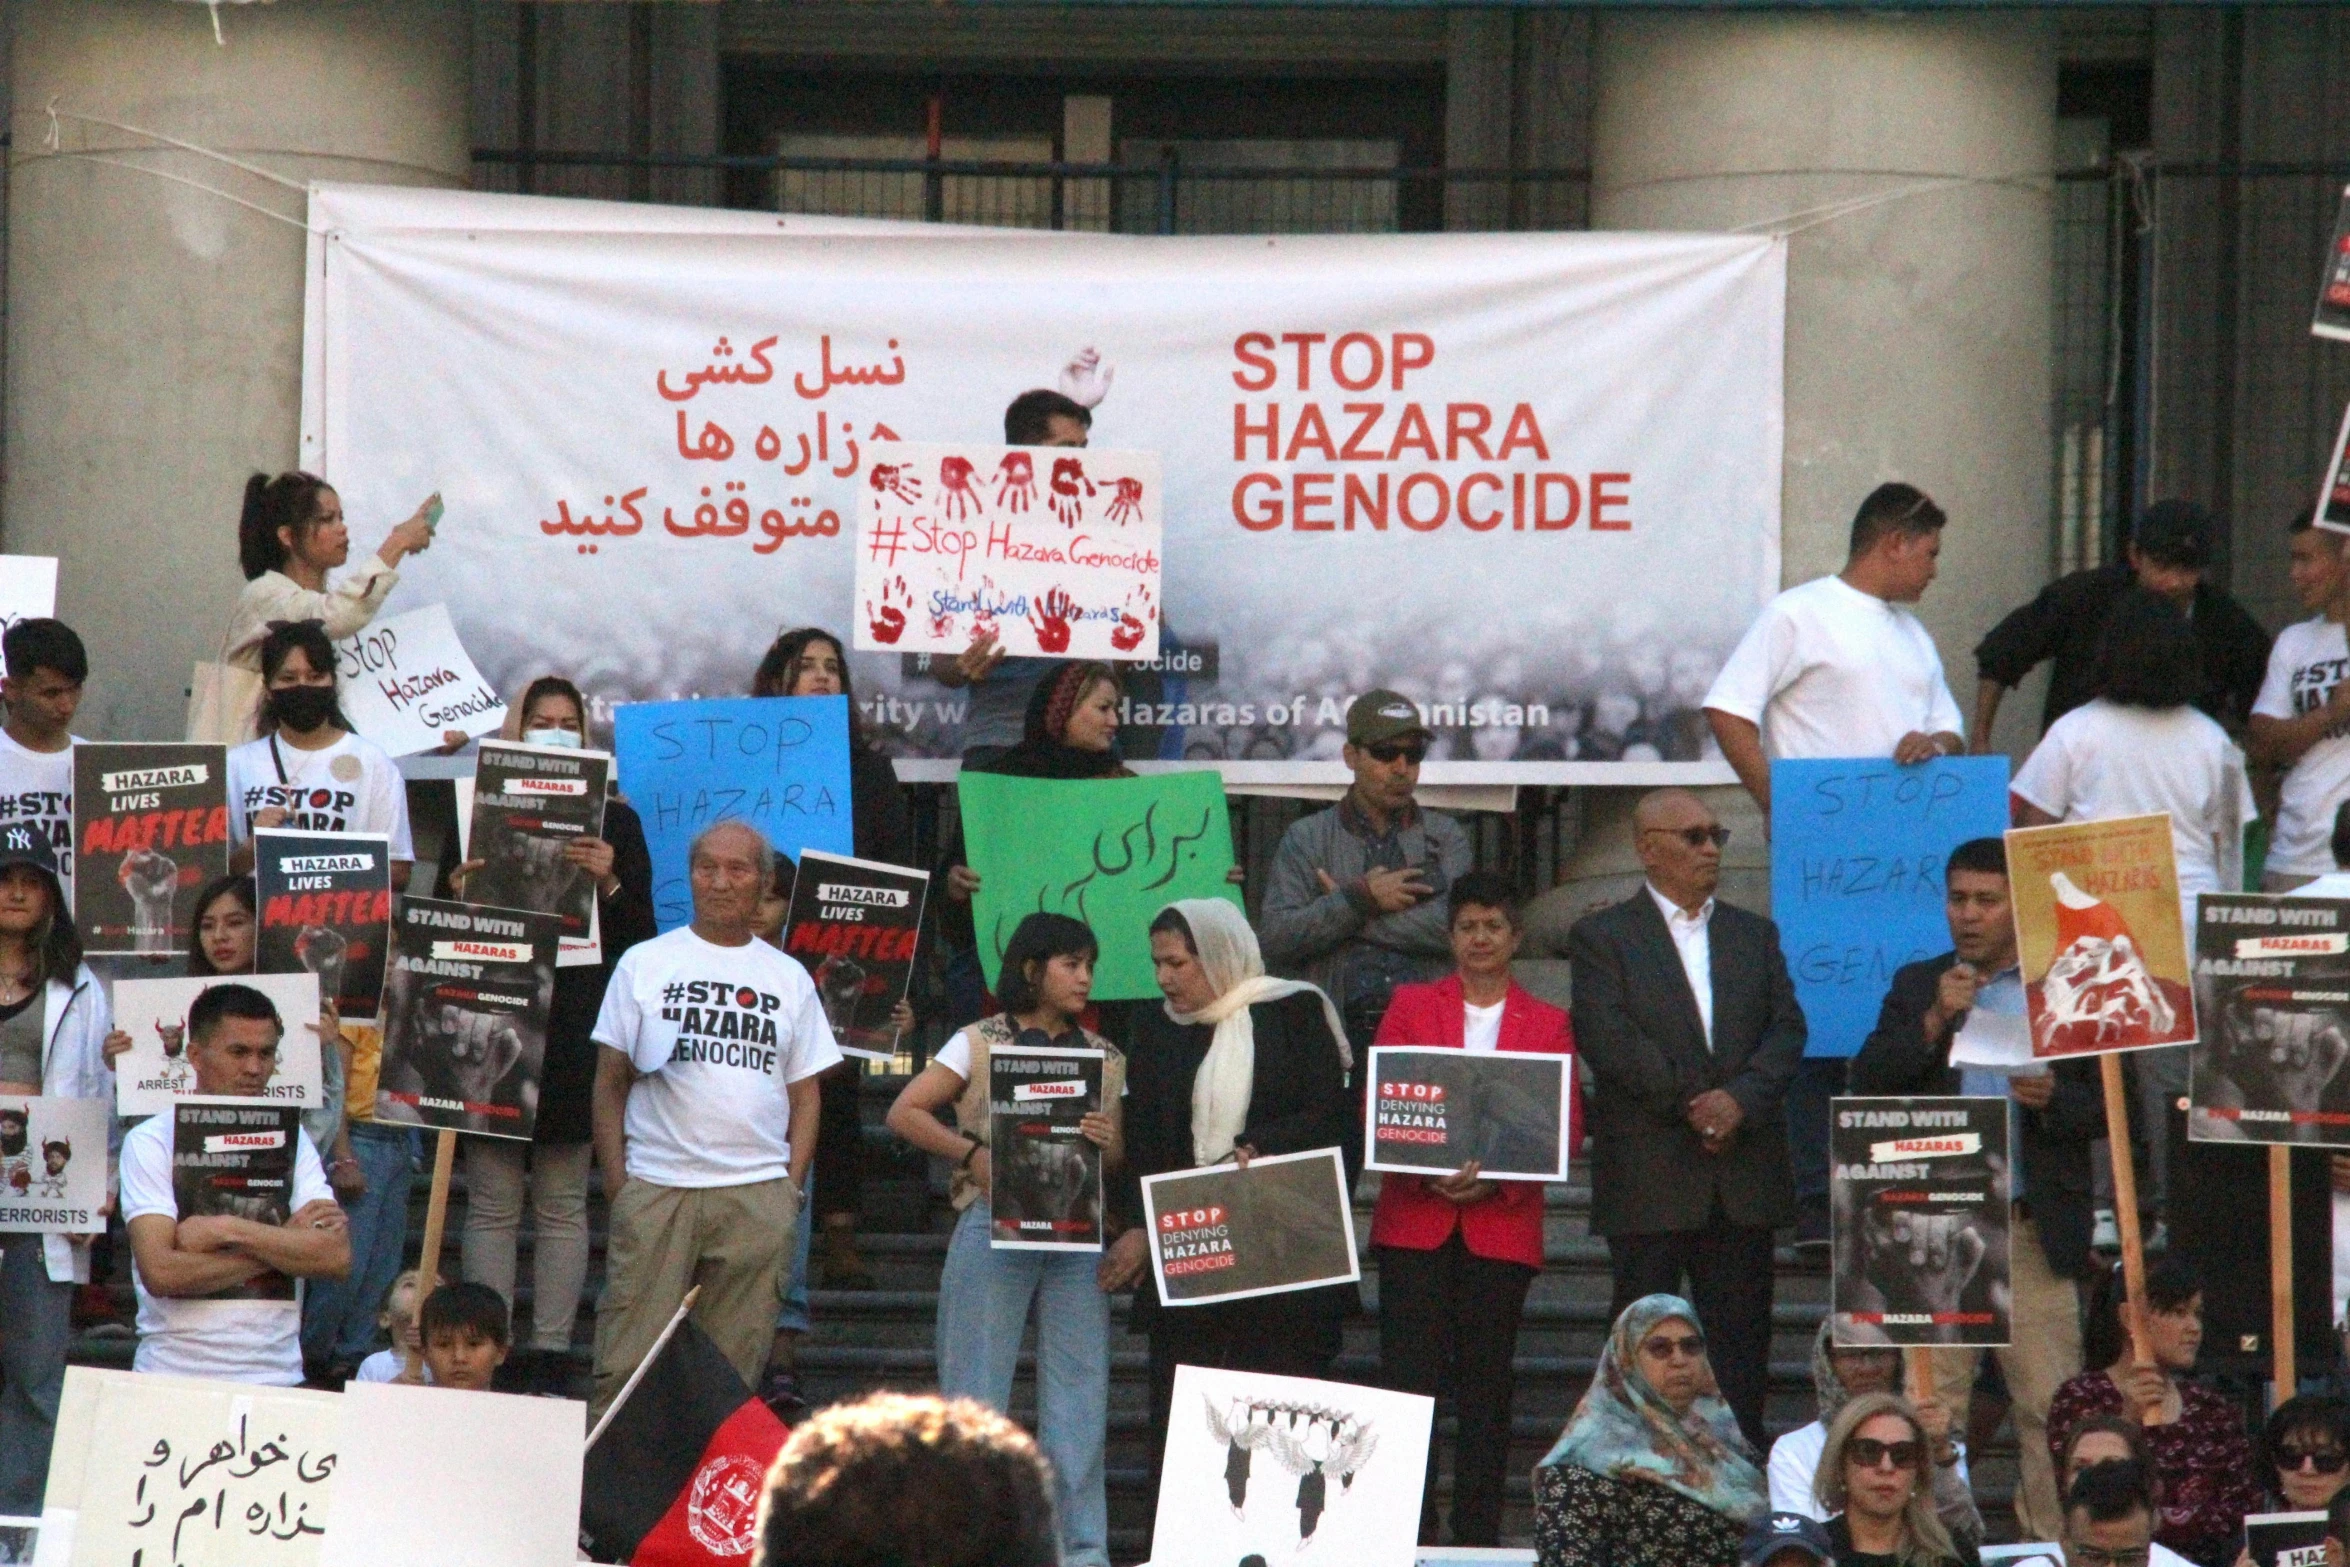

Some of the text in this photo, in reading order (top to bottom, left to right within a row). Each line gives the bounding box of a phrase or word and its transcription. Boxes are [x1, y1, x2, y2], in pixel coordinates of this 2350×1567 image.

[657, 335, 905, 402] نسل کشی
[1232, 331, 1435, 391] STOP
[676, 410, 735, 462] ها
[1234, 402, 1550, 461] HAZARA
[1232, 472, 1632, 532] GENOCIDE
[540, 481, 840, 555] متوقف کنید
[868, 516, 1160, 581] #Stop Hazara Genocide
[929, 589, 982, 617] Stand
[1267, 694, 1306, 727] of
[652, 718, 813, 775] STOP
[482, 753, 580, 775] STAND WITH
[115, 768, 196, 789] HAZARA
[521, 779, 574, 793] HAZARAS
[111, 793, 161, 812] LIVES
[244, 785, 356, 813] #STOP
[474, 792, 547, 811] AGAINST
[1815, 772, 1962, 820] STOP
[656, 784, 836, 831] HAZARA
[542, 821, 585, 833] GENOCIDE
[291, 857, 363, 872] HAZARA
[288, 875, 332, 891] LIVES
[1802, 853, 1942, 901] HAZAR
[828, 886, 898, 906] HAZARA
[407, 908, 525, 938] STAND WITH
[820, 905, 865, 922] LIVES
[2205, 906, 2338, 927] STAND WITH
[453, 942, 517, 960] HAZARAS
[2260, 937, 2332, 952] HAZARAS
[394, 955, 484, 980] AGAINST
[2199, 958, 2296, 978] AGAINST
[477, 991, 529, 1007] GENOCIDE
[663, 981, 781, 1016] #STOP
[993, 1059, 1079, 1075] STAND WITH
[136, 1078, 186, 1091] ARREST
[1029, 1083, 1075, 1095] HAZARAS
[1383, 1082, 1442, 1099] STOP
[179, 1108, 280, 1125] STAND WITH
[990, 1100, 1052, 1116] AGAINST
[1380, 1099, 1446, 1115] DENYING
[1378, 1112, 1447, 1129] HAZARA
[1839, 1110, 1968, 1128] STAND WITH
[223, 1135, 275, 1146] HAZARAS
[1376, 1127, 1447, 1144] GENOCIDE
[1894, 1140, 1964, 1152] HAZARAS
[174, 1152, 251, 1168] AGAINST
[1835, 1163, 1930, 1180] AGAINST
[247, 1178, 284, 1188] GENOCIDE
[1162, 1207, 1221, 1228] STOP
[1163, 1224, 1229, 1245] DENYING
[1163, 1238, 1233, 1260] HAZARA
[1164, 1254, 1236, 1275] GENOCIDE
[143, 1438, 171, 1467] و
[179, 1412, 289, 1490] خواهر
[127, 1473, 155, 1528] را
